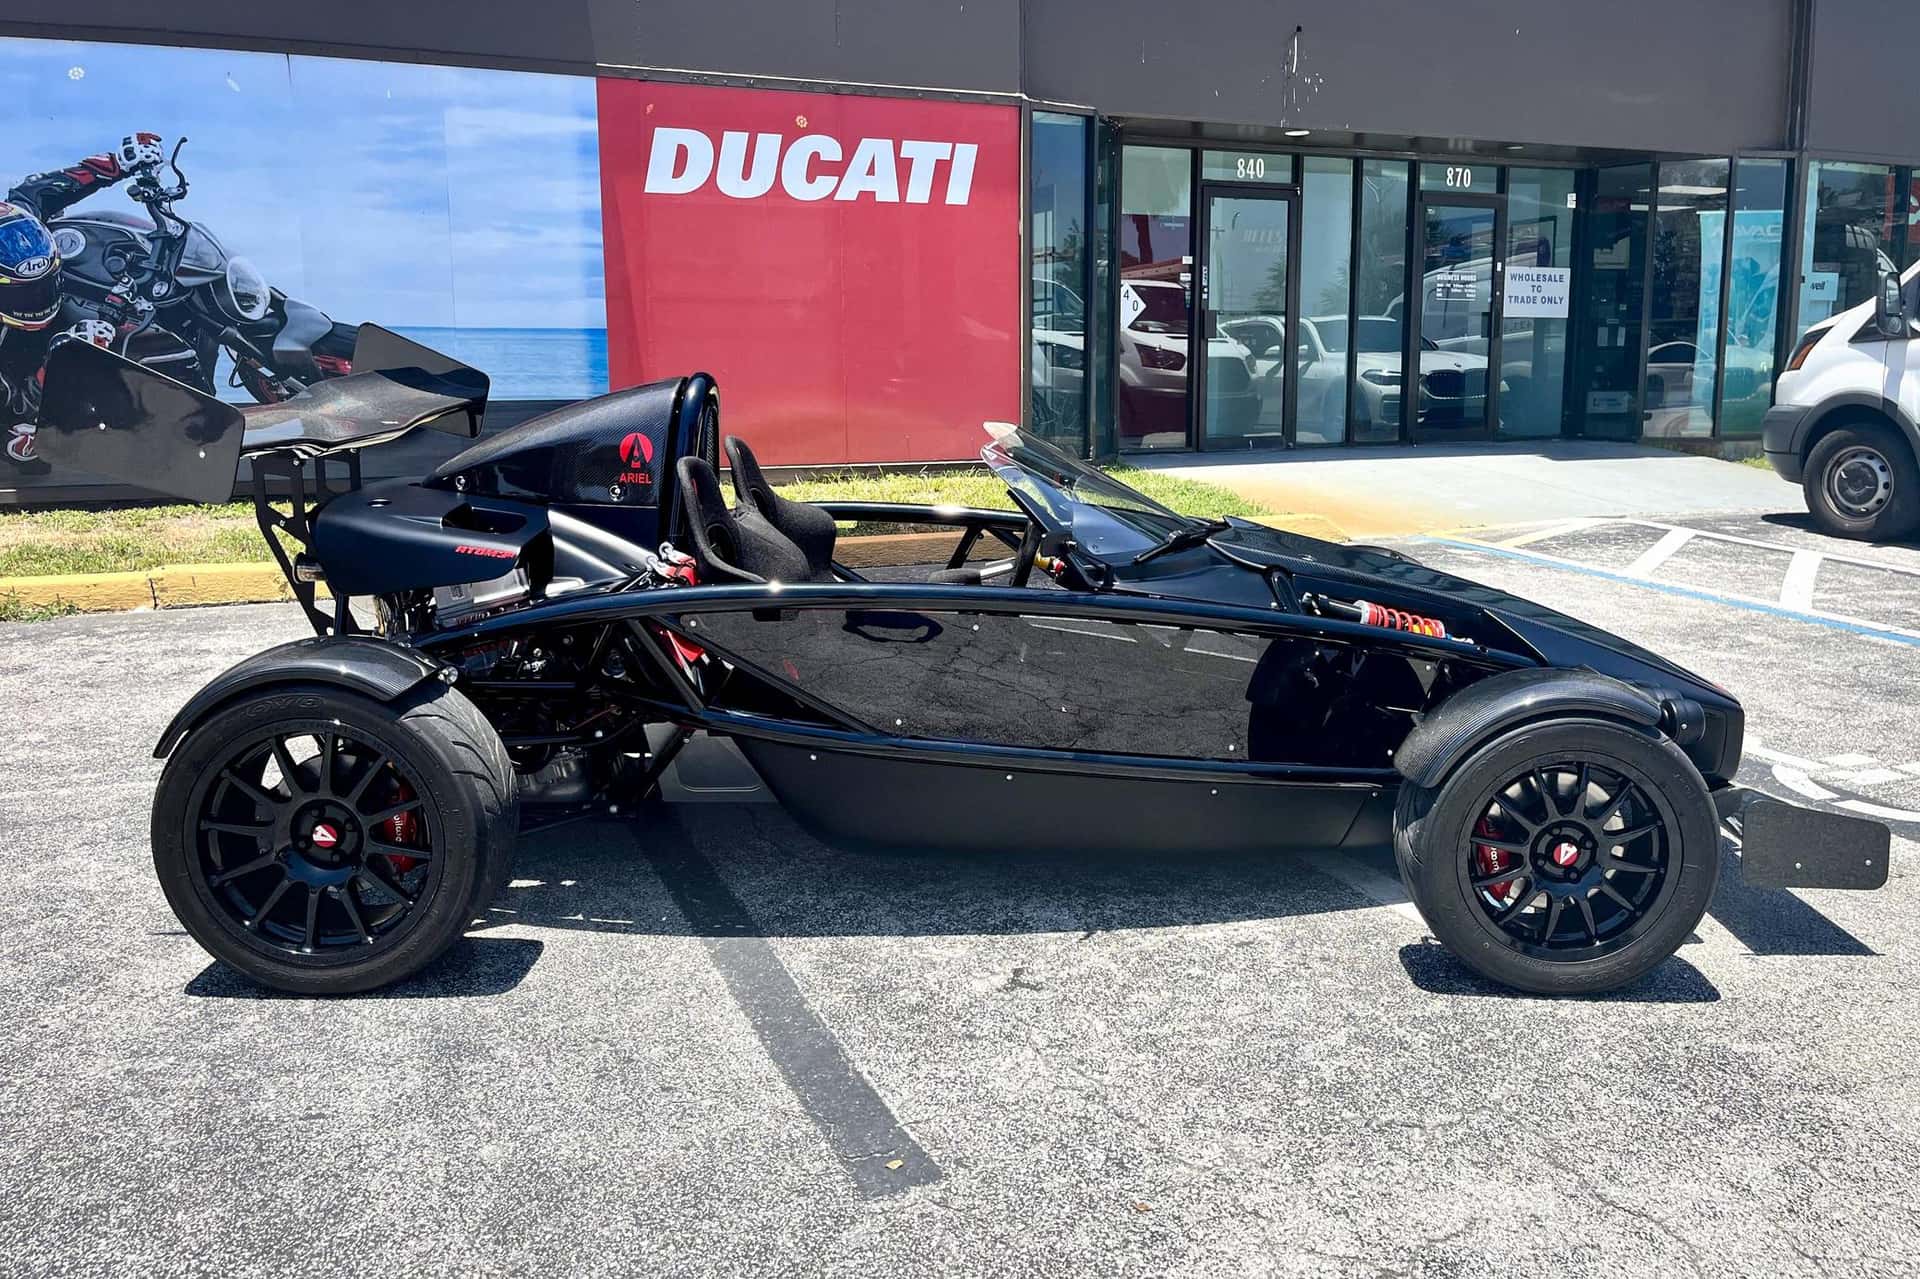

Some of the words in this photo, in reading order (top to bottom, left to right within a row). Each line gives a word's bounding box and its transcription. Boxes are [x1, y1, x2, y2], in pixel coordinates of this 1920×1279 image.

[644, 127, 978, 205] DUCATI
[1237, 158, 1265, 179] 840
[1446, 167, 1471, 188] 870
[1510, 272, 1565, 283] WHOLESALE
[1123, 289, 1129, 300] 4
[1531, 285, 1542, 293] TO
[1508, 295, 1538, 305] TRADE
[1540, 296, 1564, 305] ONLY
[619, 473, 652, 484] ARIEL
